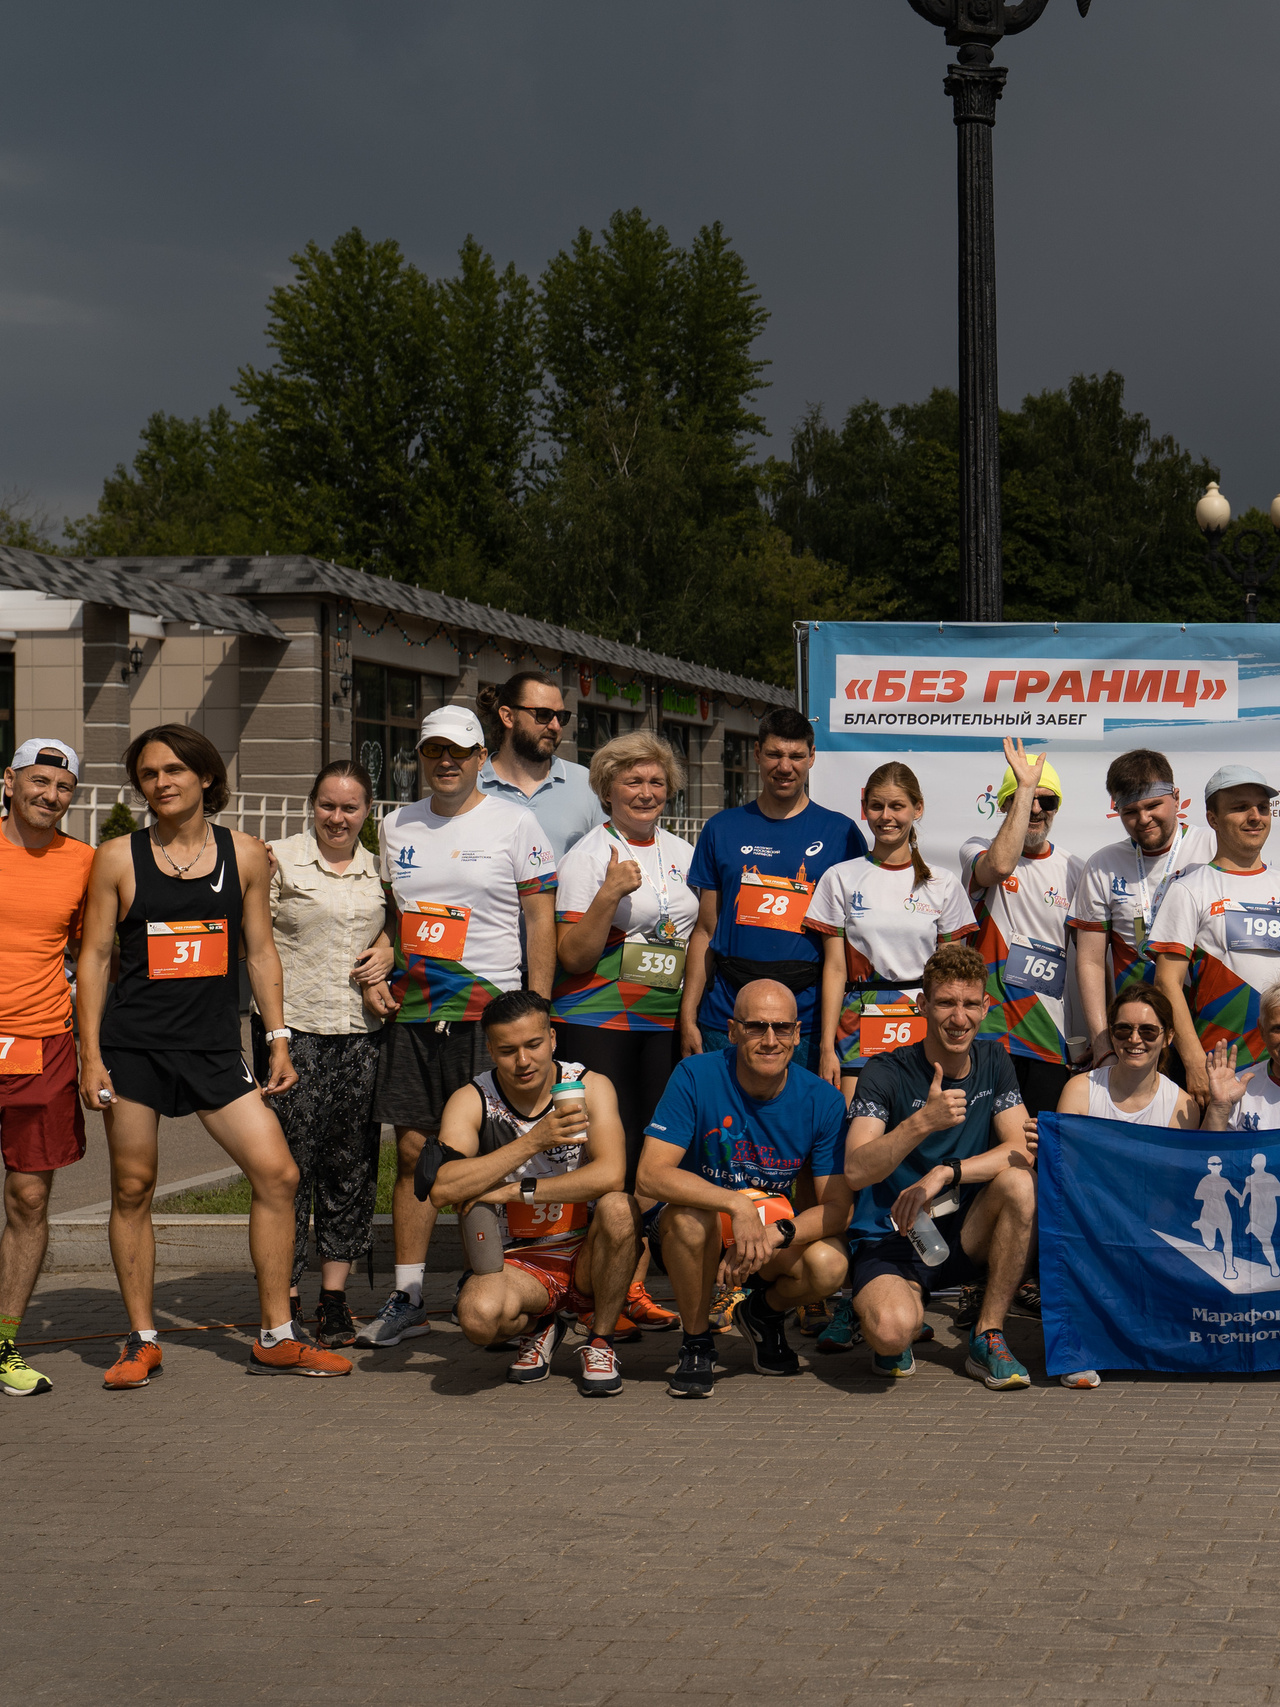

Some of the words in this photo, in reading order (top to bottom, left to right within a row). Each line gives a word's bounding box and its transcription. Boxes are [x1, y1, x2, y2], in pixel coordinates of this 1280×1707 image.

[844, 669, 969, 703] «БЕЗ
[983, 669, 1227, 708] ГРАНИЦ»
[844, 711, 1032, 726] БЛАГОТВОРИТЕЛЬНЫЙ
[1035, 713, 1088, 726] ЗАБЕГ
[757, 893, 790, 915] 28
[416, 920, 445, 943] 49
[1243, 917, 1280, 938] 198
[173, 940, 202, 963] 31
[637, 951, 677, 975] 339
[1023, 955, 1059, 981] 165
[881, 1022, 911, 1044] 56
[732, 1151, 757, 1162] ДЛЯ
[735, 1140, 776, 1157] СПОРТ
[531, 1203, 564, 1224] 38
